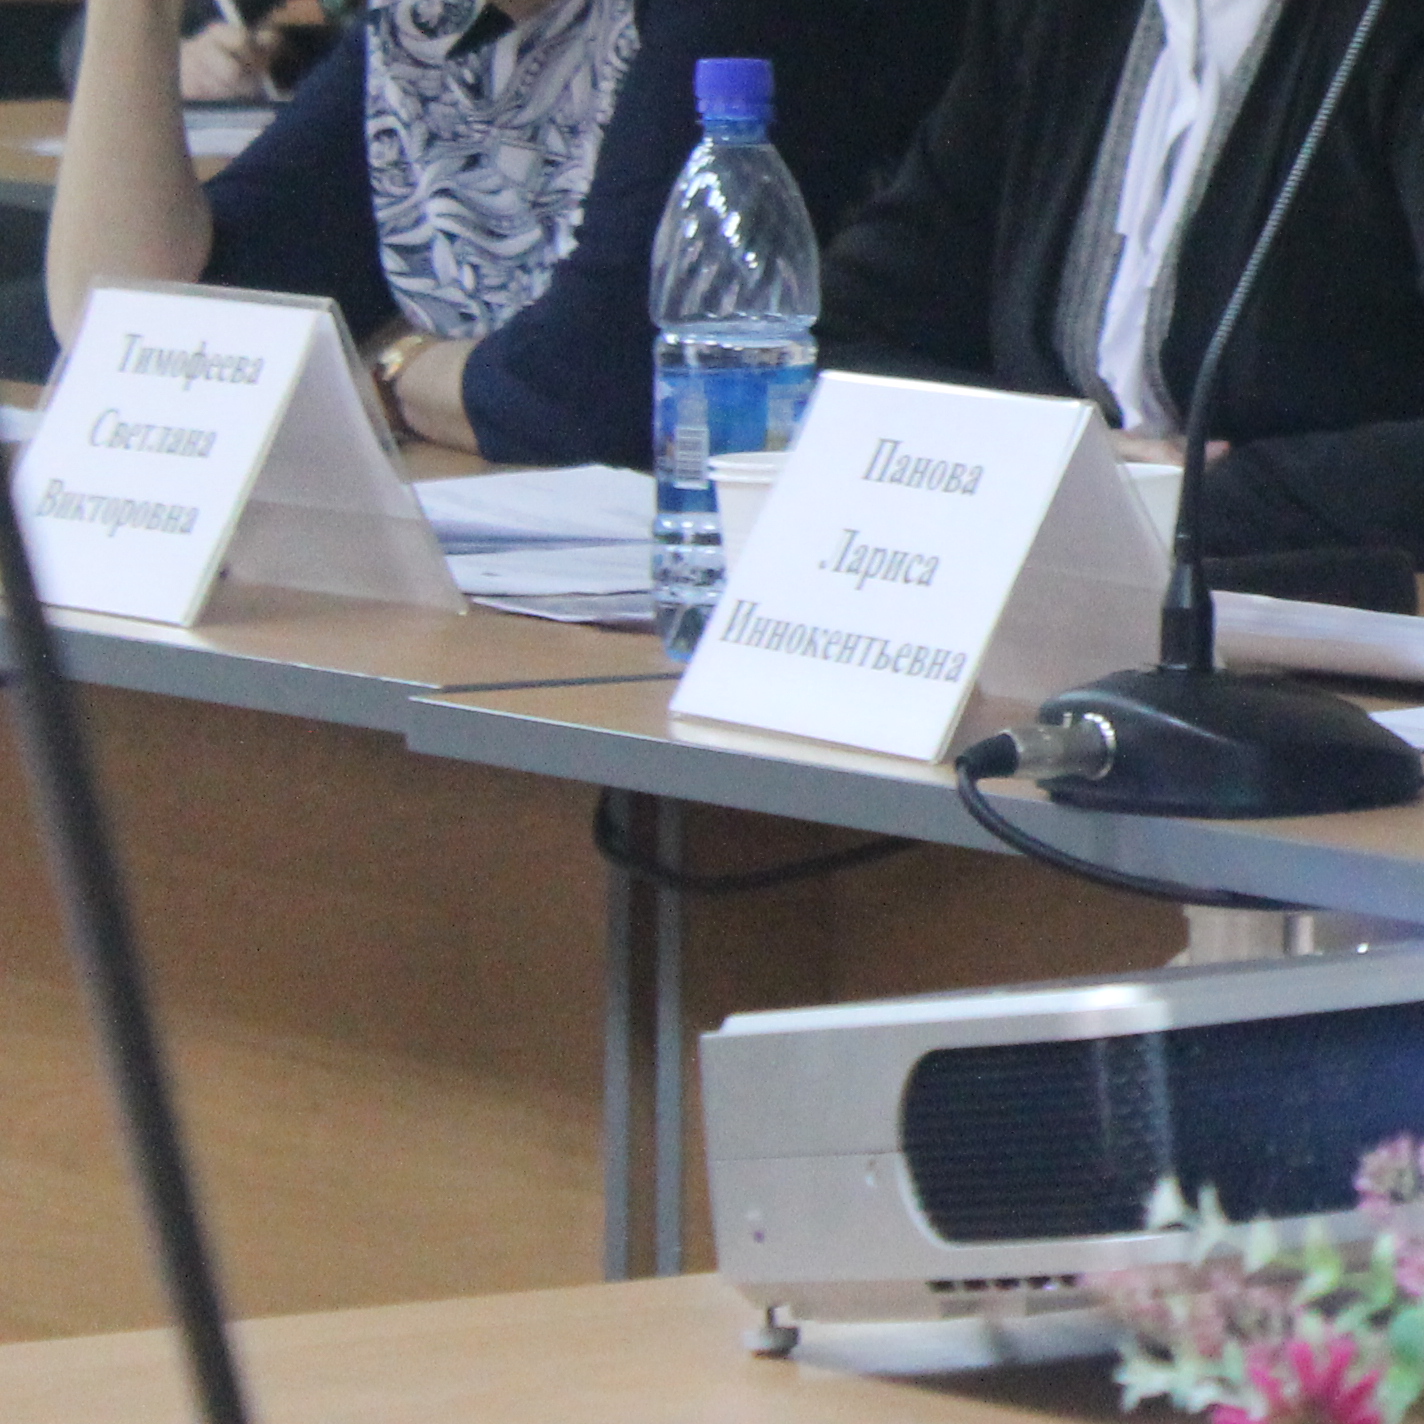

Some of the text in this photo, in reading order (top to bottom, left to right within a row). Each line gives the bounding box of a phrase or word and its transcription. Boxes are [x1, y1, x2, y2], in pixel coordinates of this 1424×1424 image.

[117, 333, 265, 391] Тимофеева
[89, 408, 217, 458] Светлана
[862, 437, 984, 495] Панова
[36, 478, 200, 537] Викторовна
[818, 528, 940, 591] Лариса
[719, 599, 968, 683] Иннокентьевна
